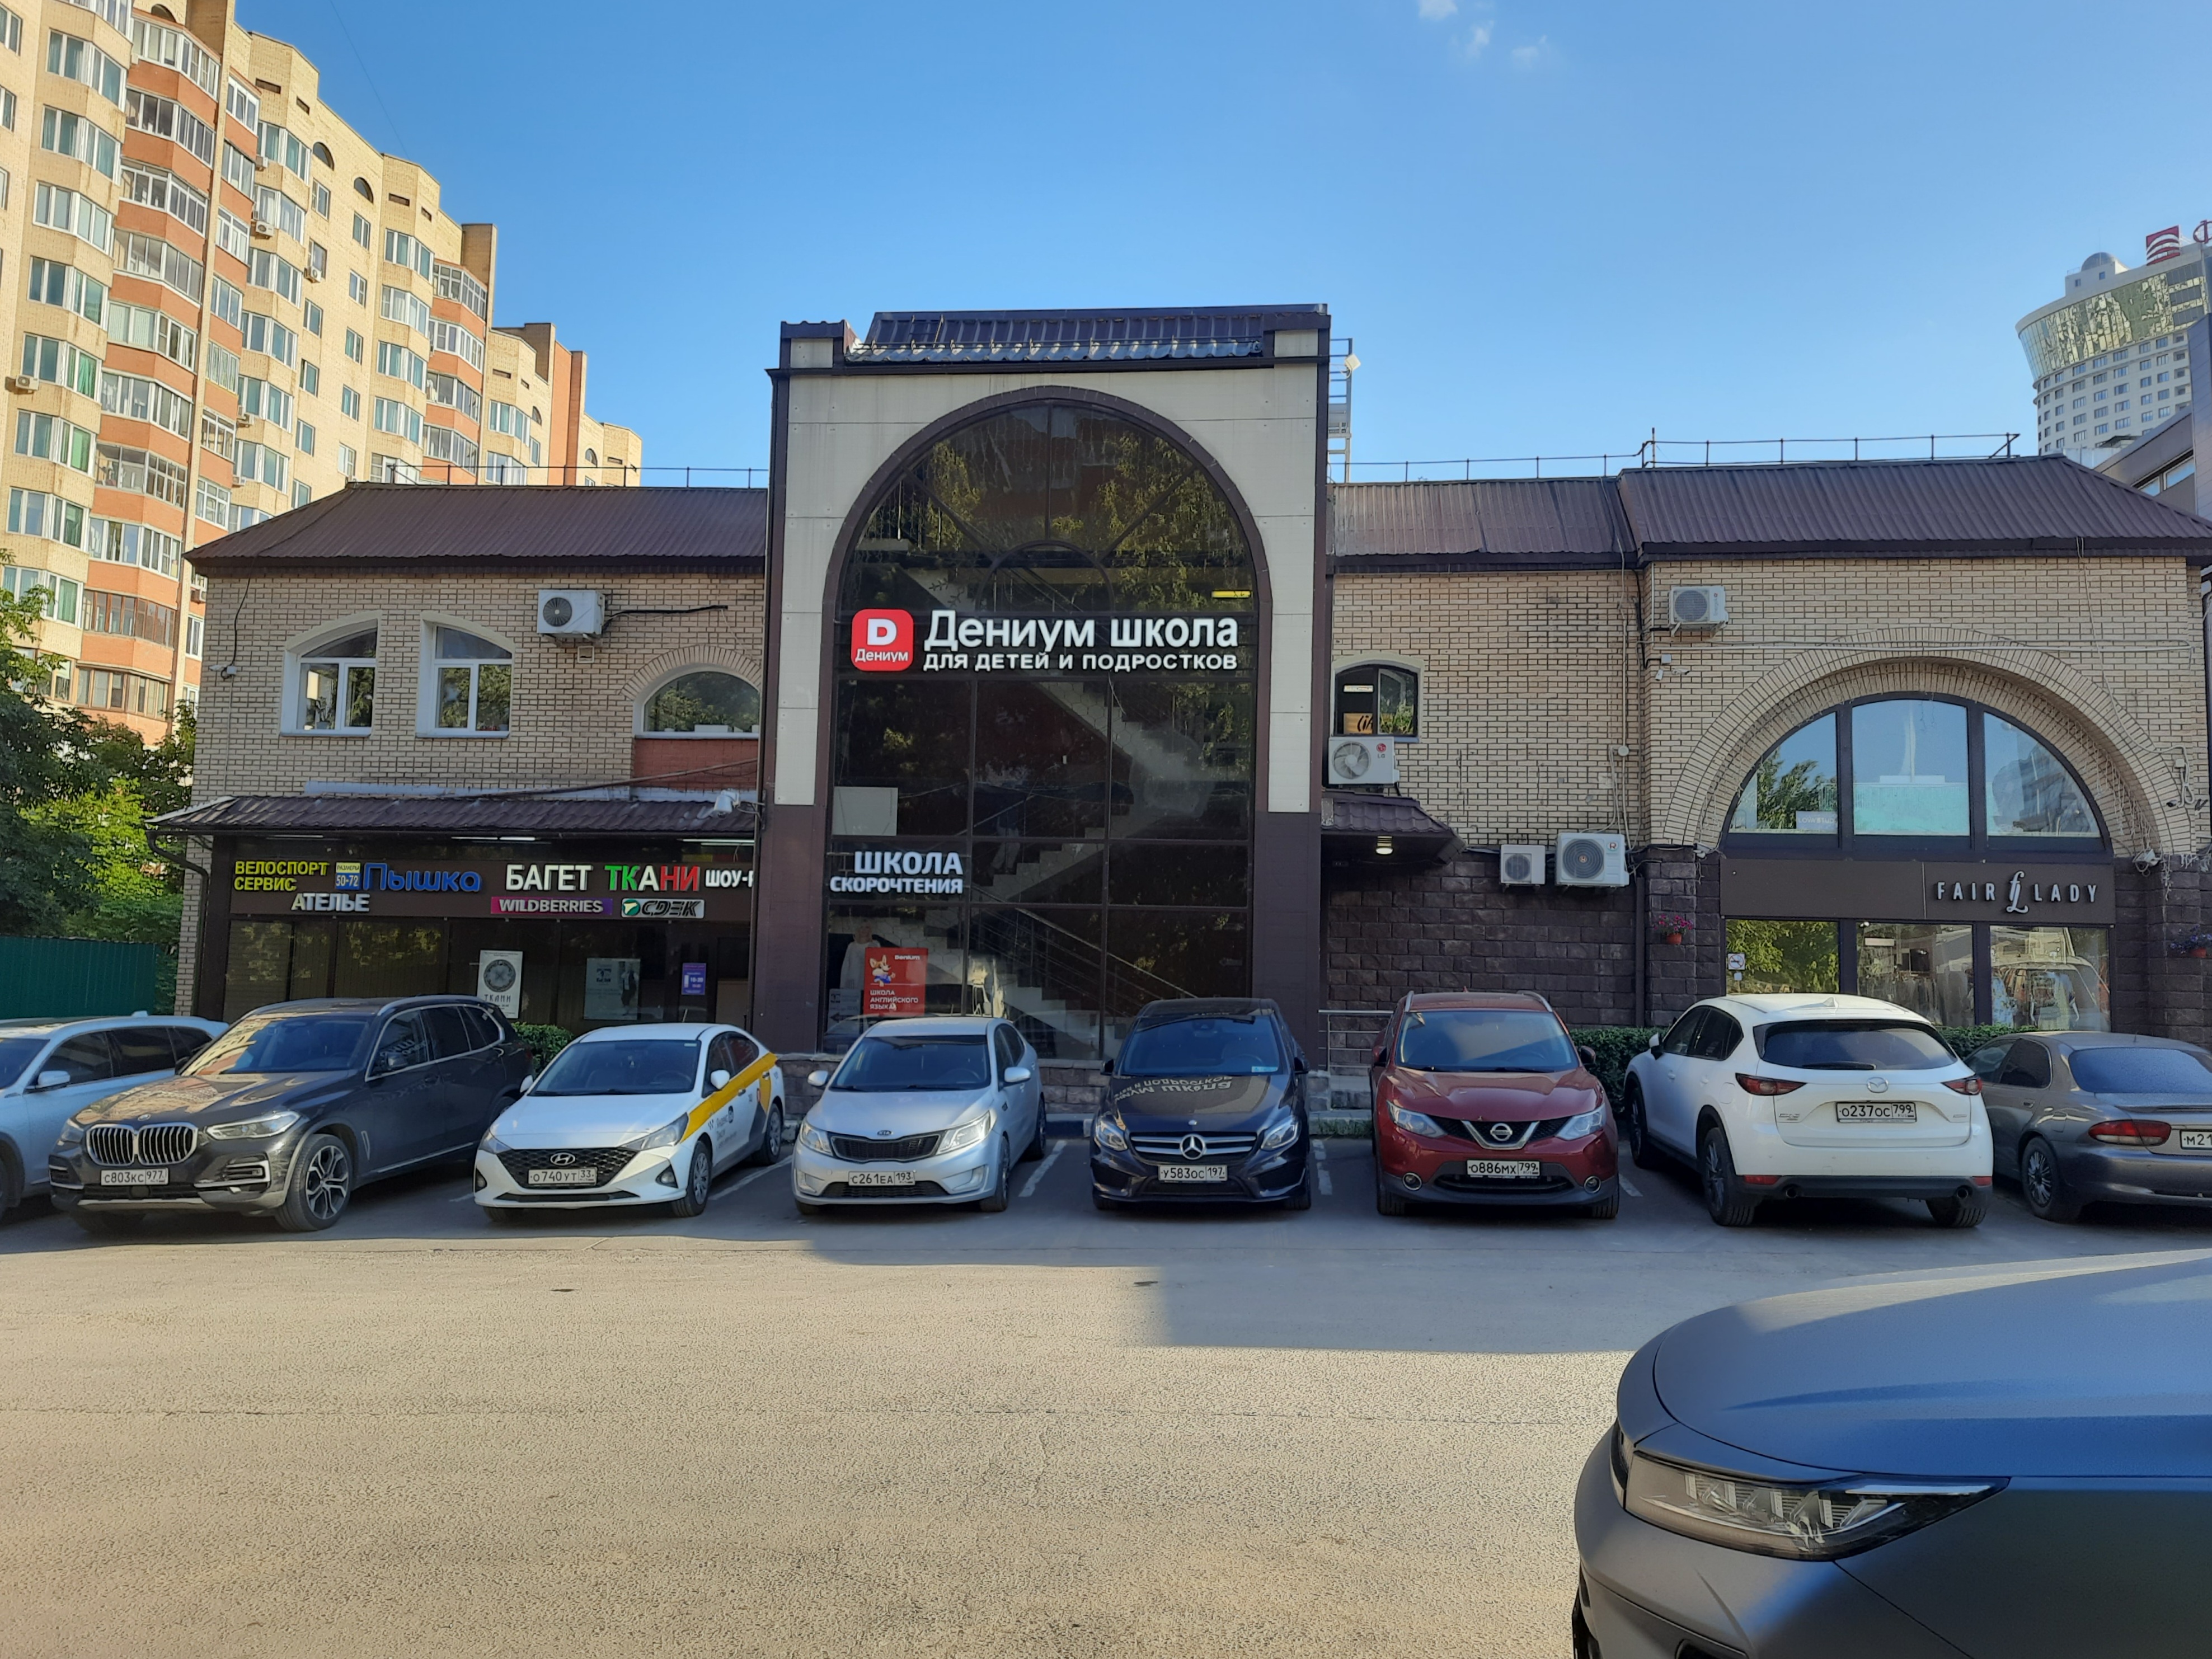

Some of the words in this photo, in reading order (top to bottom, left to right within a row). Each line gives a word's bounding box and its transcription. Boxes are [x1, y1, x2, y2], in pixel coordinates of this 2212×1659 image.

[867, 618, 898, 646] D
[924, 609, 1095, 652] Дениум
[1110, 617, 1238, 647] школа
[855, 648, 908, 662] Дениум
[234, 861, 330, 876] ВЕЛОСПОРТ
[854, 850, 963, 875] ШКОЛА
[234, 877, 297, 891] СЕРВИС
[336, 875, 359, 887] 50-72
[364, 862, 482, 892] Пышка
[506, 864, 593, 891] БАГЕТ
[604, 865, 701, 891] ТКАНИ
[830, 876, 963, 894] СКОРОЧТЕНИЯ
[1937, 882, 1995, 900] FAIR
[2034, 883, 2097, 902] LADY
[291, 893, 370, 911] АТЕЛЬЕ
[499, 899, 604, 913] WILDBERRIES
[1892, 1104, 1912, 1113] 799
[1208, 1167, 1223, 1176] 197
[1519, 1162, 1536, 1172] 799
[895, 1172, 911, 1181] 193
